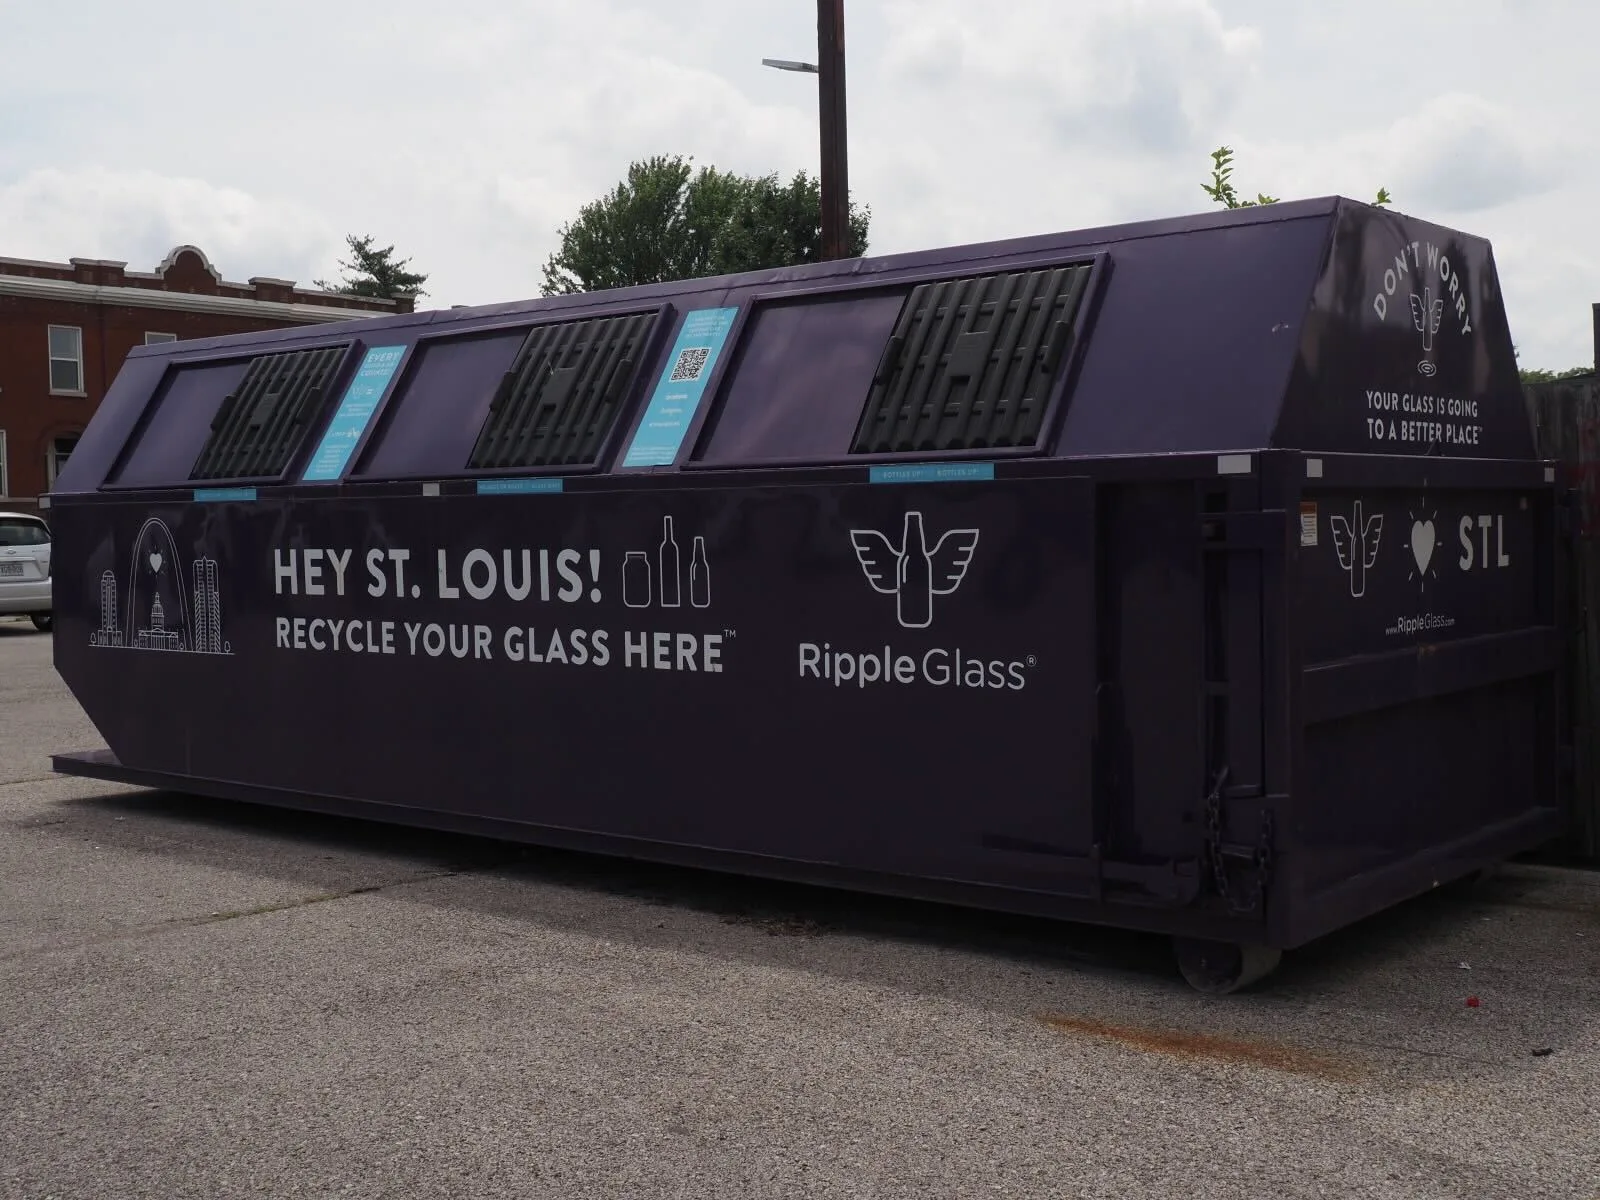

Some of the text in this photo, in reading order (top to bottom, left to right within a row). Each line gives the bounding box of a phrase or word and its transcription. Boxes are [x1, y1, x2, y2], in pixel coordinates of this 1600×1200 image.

[1374, 241, 1471, 335] DON'T WORRY
[1366, 390, 1478, 418] YOUR GLASS IS GOING
[1367, 418, 1385, 440] TO
[1388, 420, 1397, 440] A
[1401, 420, 1442, 443] BETTER
[1459, 514, 1510, 571] STL
[274, 548, 602, 603] HEY ST. LOUIS!
[275, 616, 396, 654] RECYCLE
[403, 622, 493, 660] YOUR
[503, 626, 610, 667] GLASS
